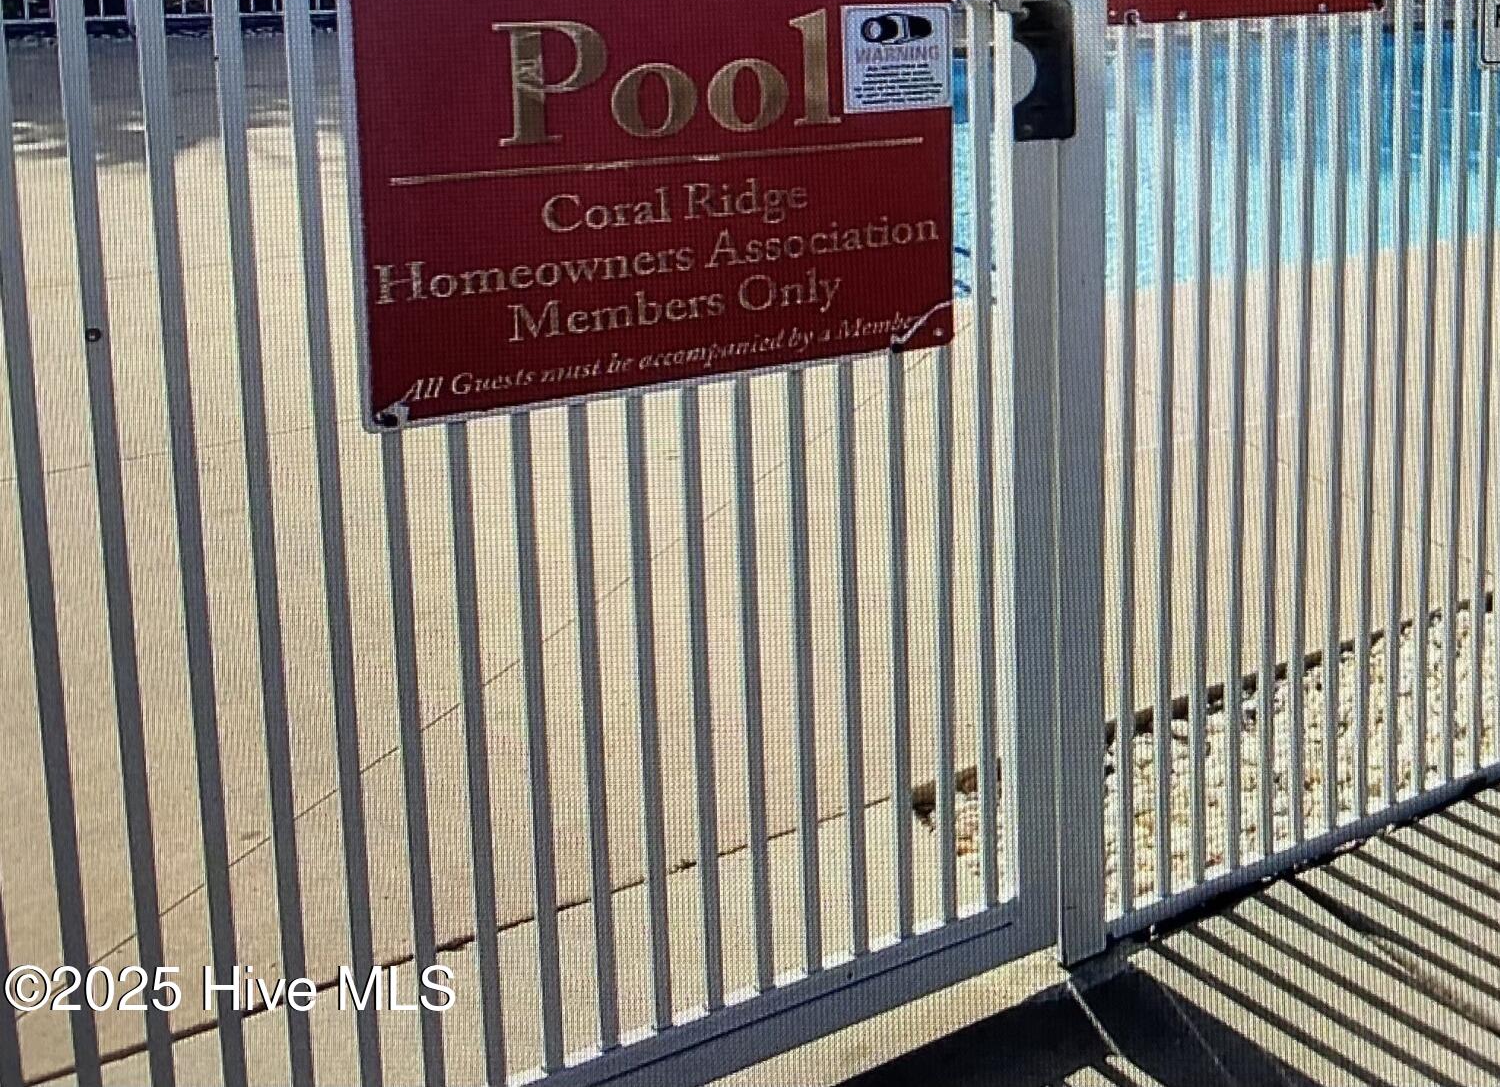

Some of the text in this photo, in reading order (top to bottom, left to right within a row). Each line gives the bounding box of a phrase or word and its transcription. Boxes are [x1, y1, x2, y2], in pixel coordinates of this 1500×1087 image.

[491, 7, 841, 146] Pool
[855, 44, 940, 64] WARNING
[541, 177, 808, 233] Coral Ridge
[374, 215, 940, 304] Homeowners Association
[507, 267, 843, 343] Members Only
[401, 375, 444, 402] All
[451, 369, 537, 395] Guests
[540, 359, 601, 383] must
[606, 352, 633, 373] be
[638, 334, 783, 368] accompanied
[787, 327, 812, 352] by
[820, 328, 831, 341] a
